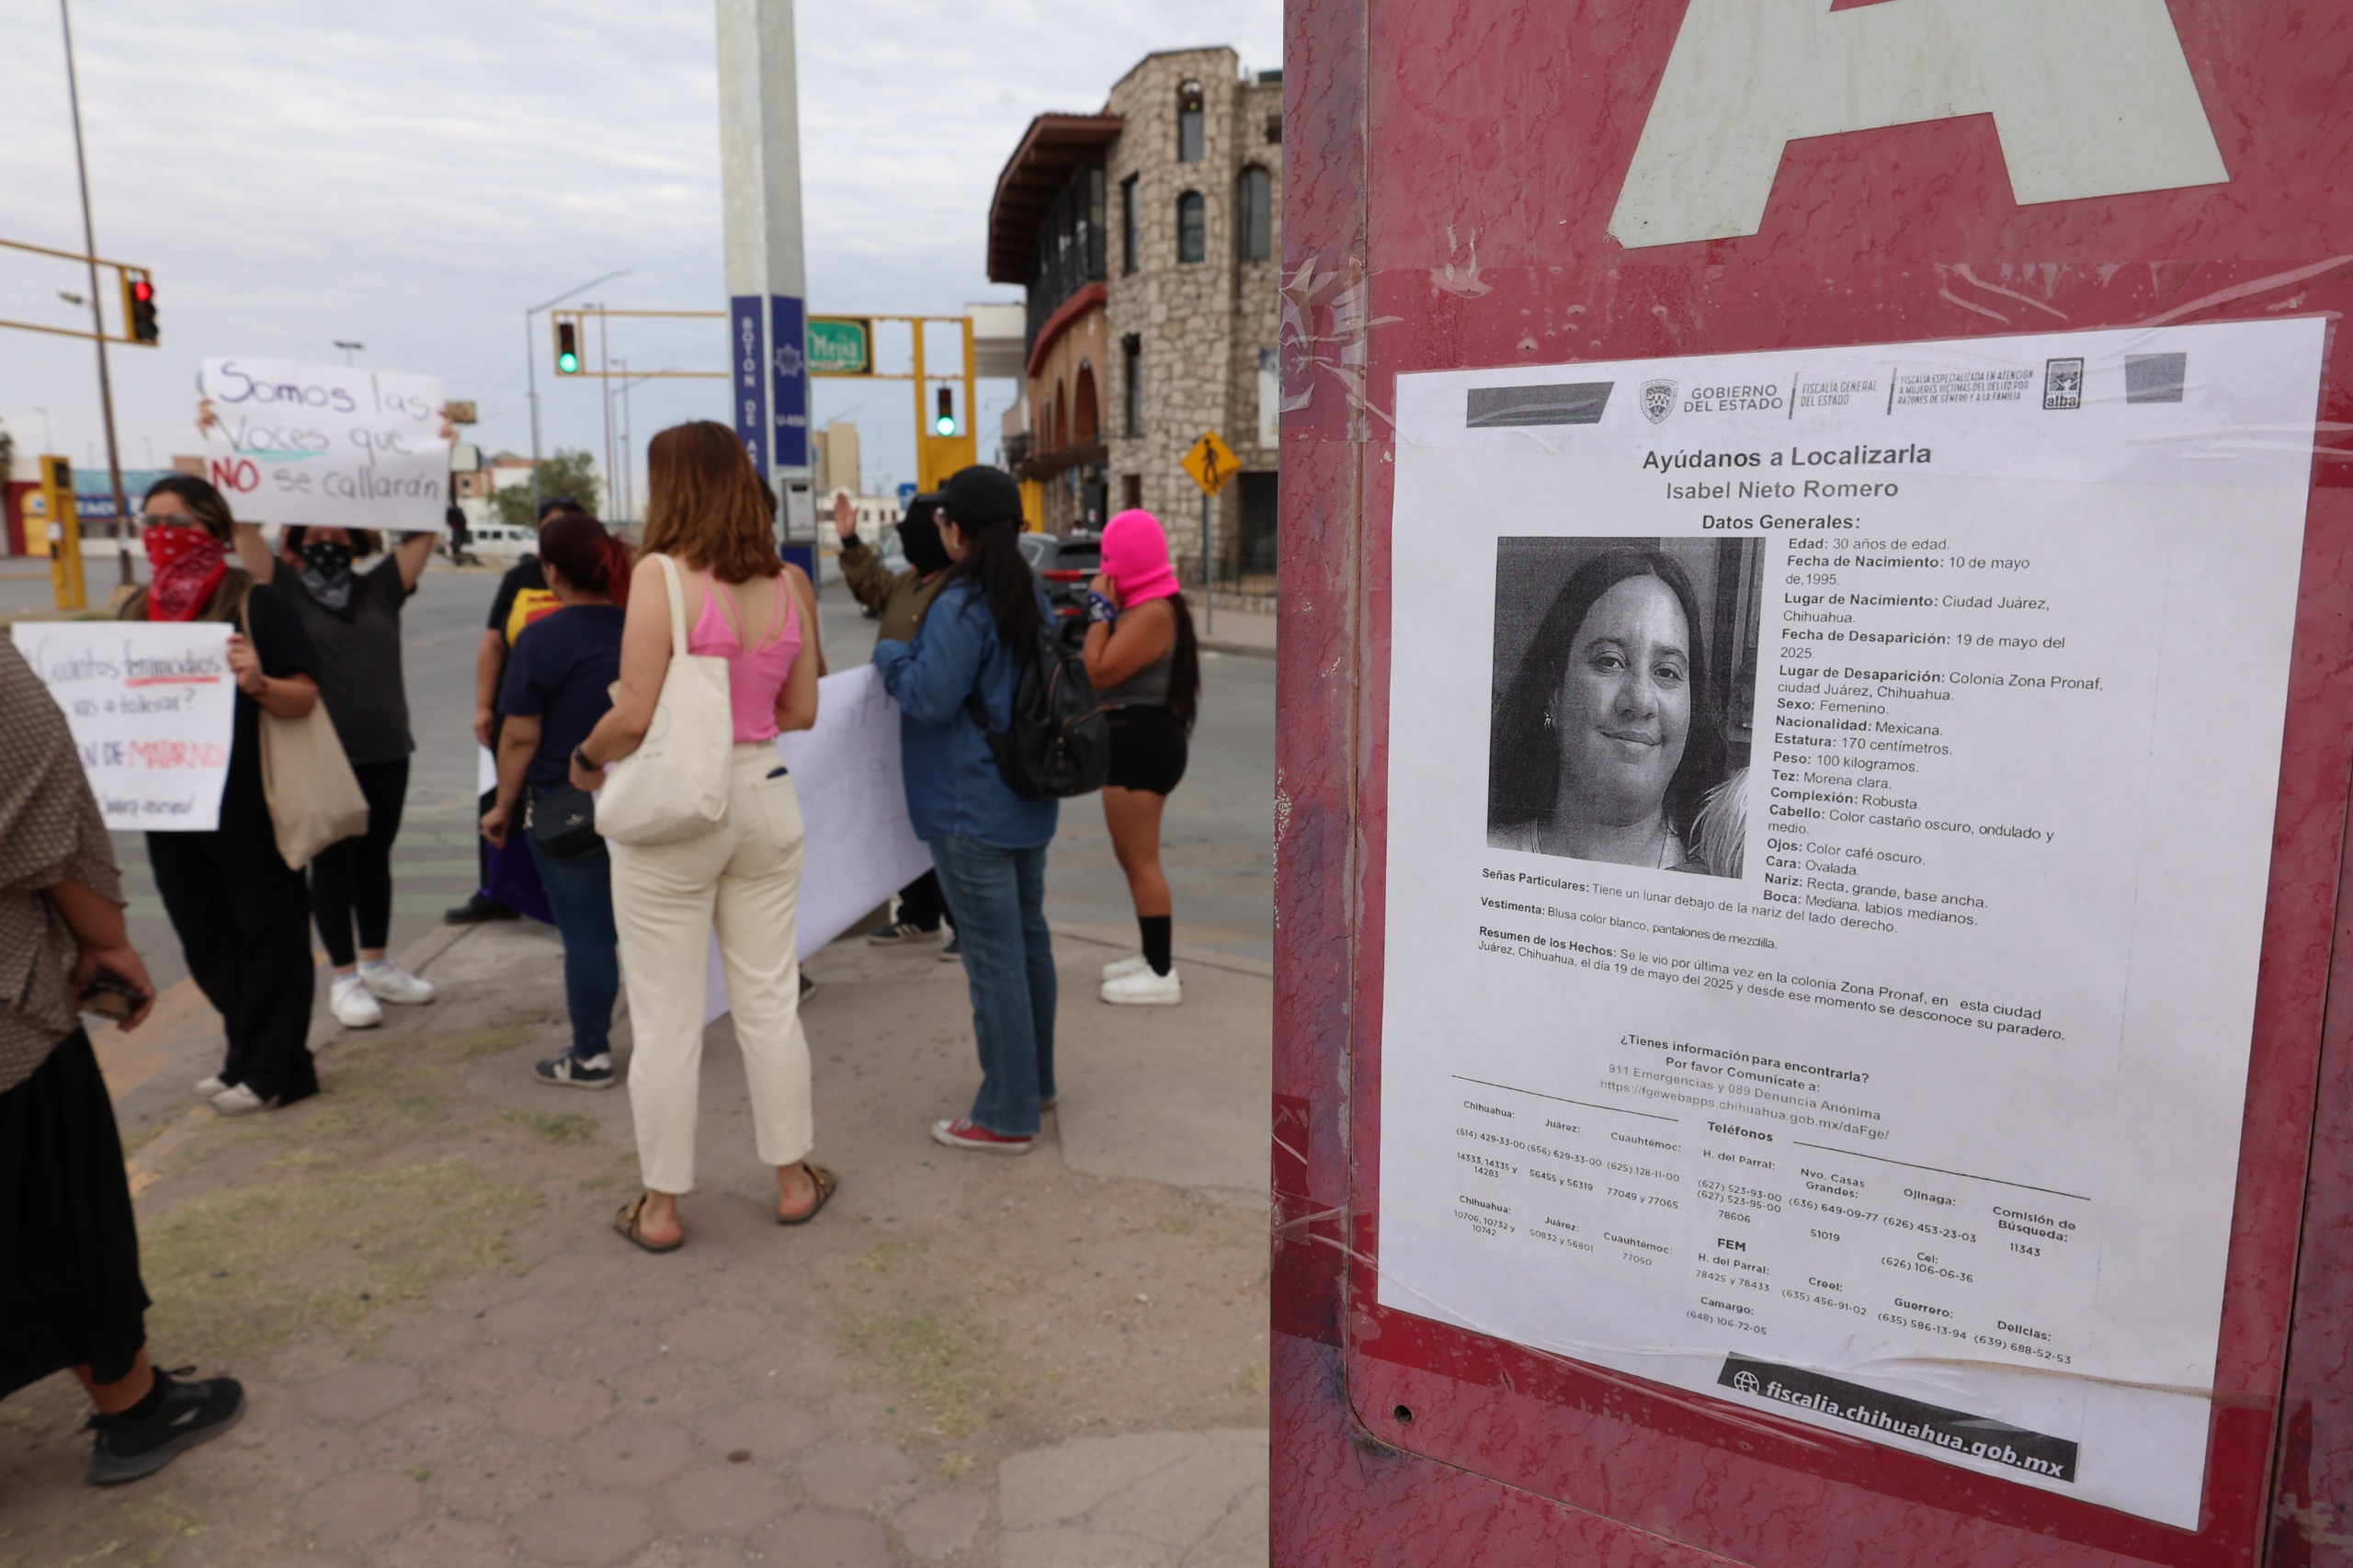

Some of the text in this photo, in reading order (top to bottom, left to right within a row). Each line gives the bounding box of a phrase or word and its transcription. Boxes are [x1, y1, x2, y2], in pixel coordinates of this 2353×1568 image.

[1985, 371, 1996, 381] EN
[218, 361, 430, 421] Somos las
[1691, 384, 1777, 400] GOBIERNO
[1840, 381, 1877, 393] GENERAL
[1684, 397, 1783, 413] DEL ESTADO
[1801, 393, 1849, 407] DEL ESTADO
[2046, 395, 2076, 407] alba
[214, 414, 414, 465] Voces que
[1643, 443, 1931, 474] Ayúdanos a Localizarla
[210, 458, 259, 493] NO
[273, 468, 313, 494] se
[1667, 480, 1899, 500] Isabel Nieto Romero
[1702, 515, 1860, 529] Datos Generales:
[1789, 538, 1949, 550] Edad: 30 años de edad.
[1788, 555, 2030, 572] Fecha de Nacimiento: 10 de mayo
[1785, 592, 2050, 611] Lugar de Nacimiento: Ciudad Juárez,
[1783, 610, 1856, 623] Chihuahua.
[1782, 629, 2065, 651] Fecha de Desaparición: 19 de mayo del
[1780, 647, 1814, 659] 2025.
[1779, 665, 2103, 691] Lugar de Desaparición: Colonia Zona Pronaf,
[1778, 682, 1954, 701] ciudad Juárez, Chihuahua.
[1777, 698, 1889, 714] Sexo: Femenino.
[1776, 715, 1942, 736] Nacionalidad: Mexicana.
[1775, 733, 1952, 756] Estatura: 170 centímetros.
[1774, 751, 1919, 772] Peso: 100 kilogramos.
[1772, 769, 1892, 790] Tez: Morena clara.
[1770, 787, 1921, 810] Complexión: Robusta.
[1768, 823, 1809, 835] medio.
[1769, 804, 2054, 844] Cabello: Color castaño oscuro, ondulado y
[1767, 838, 1926, 865] Ojos: Color café oscuro.
[1766, 856, 1859, 876] Cara: Ovalada.
[1483, 868, 1897, 933] Señas Particulares: Tiene un lunar debajo de la nariz del lado derecho.
[1765, 872, 1987, 908] Nariz: Recta, grande, base ancha.
[1763, 890, 1977, 926] Boca: Mediana, labios medianos.
[1620, 1034, 1870, 1084] ¿Tienes información para encontrarla?
[1665, 1057, 1820, 1092] Por favor Comunícate a:
[1609, 1064, 1881, 1120] 911 Emergencias y 089 Denuncia Anónima
[1463, 1101, 1515, 1119] Chihuahua:
[1708, 1121, 1773, 1142] Teléfonos
[1611, 1132, 1681, 1153] Cuauhtémoc:
[1806, 1181, 1859, 1199] Grandes:
[1719, 1210, 1751, 1223] 78606
[1811, 1229, 1840, 1242] 51019
[1998, 1220, 2068, 1242] Búsqueda:
[1718, 1238, 1746, 1252] FEM
[1700, 1297, 1754, 1315] Camargo:
[1894, 1298, 1953, 1319] Guerrero:
[1997, 1320, 2052, 1342] Delicias:
[1767, 1381, 2064, 1478] fiscalia.chihuahua.gob.mx
